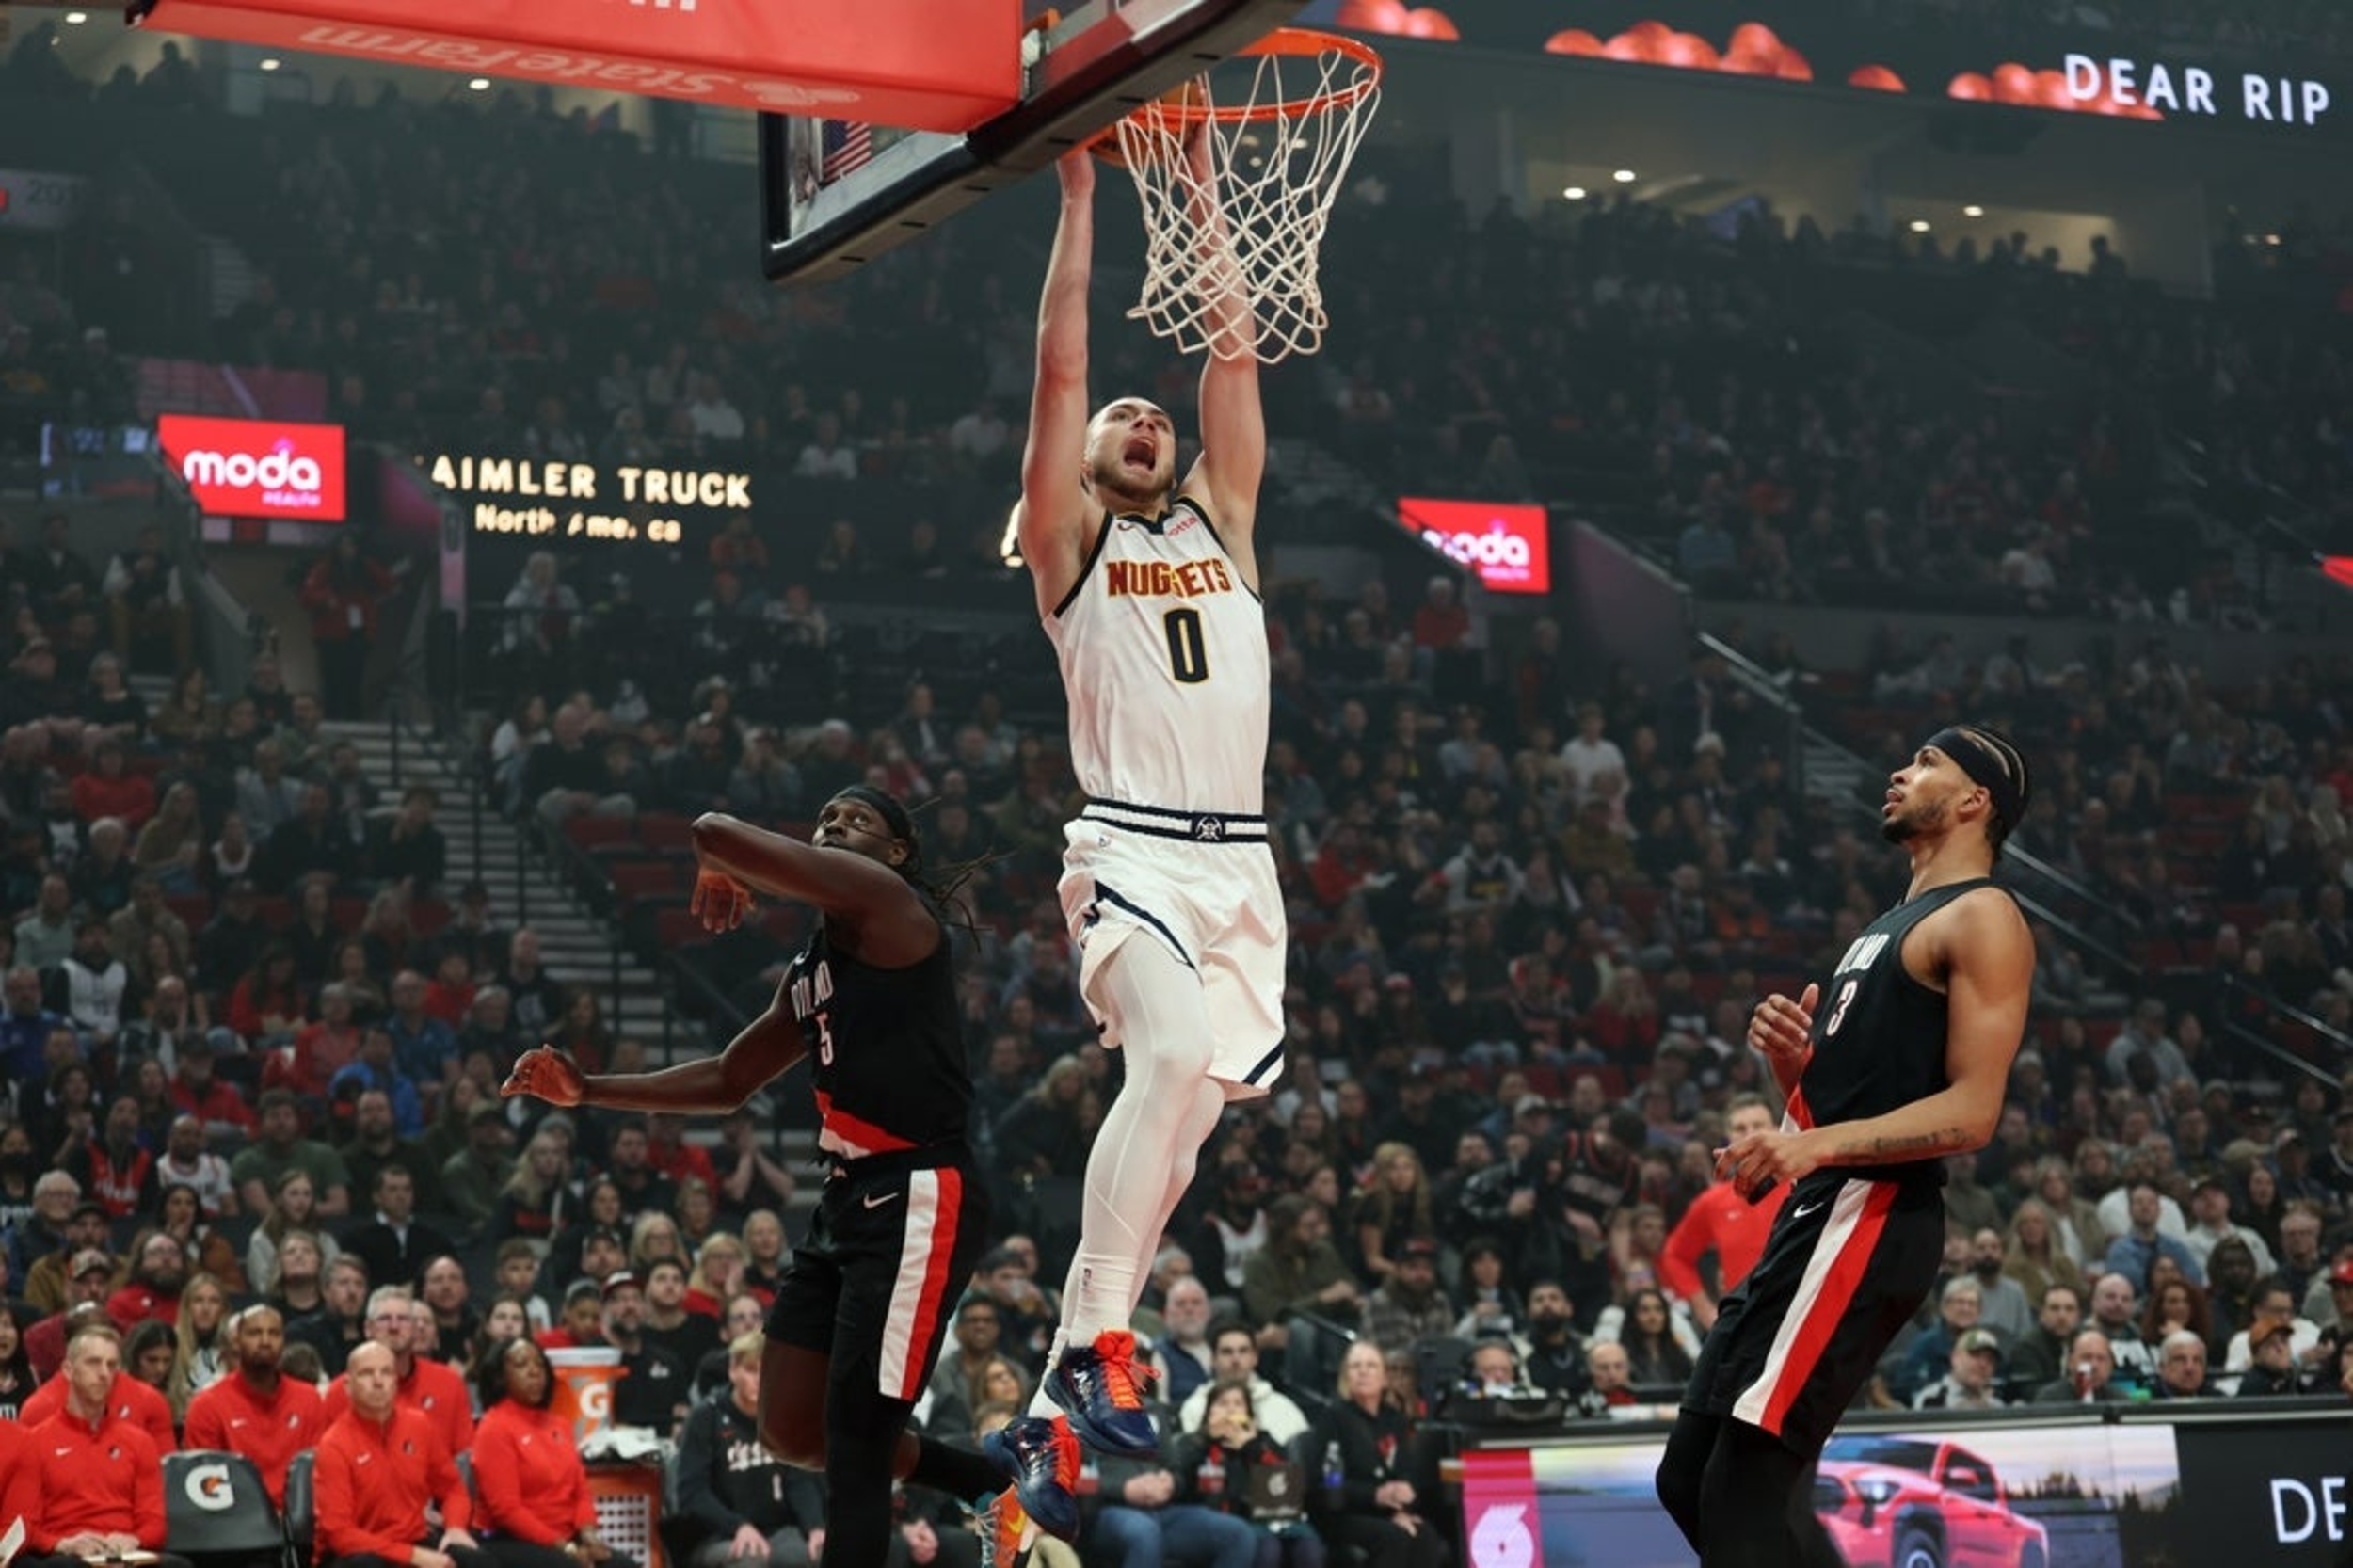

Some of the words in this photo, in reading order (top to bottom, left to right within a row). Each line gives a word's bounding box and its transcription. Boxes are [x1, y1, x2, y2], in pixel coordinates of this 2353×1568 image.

[2064, 53, 2217, 115] DEAR
[2242, 73, 2329, 125] RIP
[184, 446, 322, 491] moda
[414, 454, 597, 499] AIMLER
[617, 468, 751, 509] TRUCK
[1162, 607, 1209, 684] 0
[1826, 979, 1858, 1036] 3
[815, 1011, 834, 1066] 5
[579, 1384, 608, 1418] G
[185, 1464, 234, 1512] G
[2270, 1476, 2347, 1543] DE
